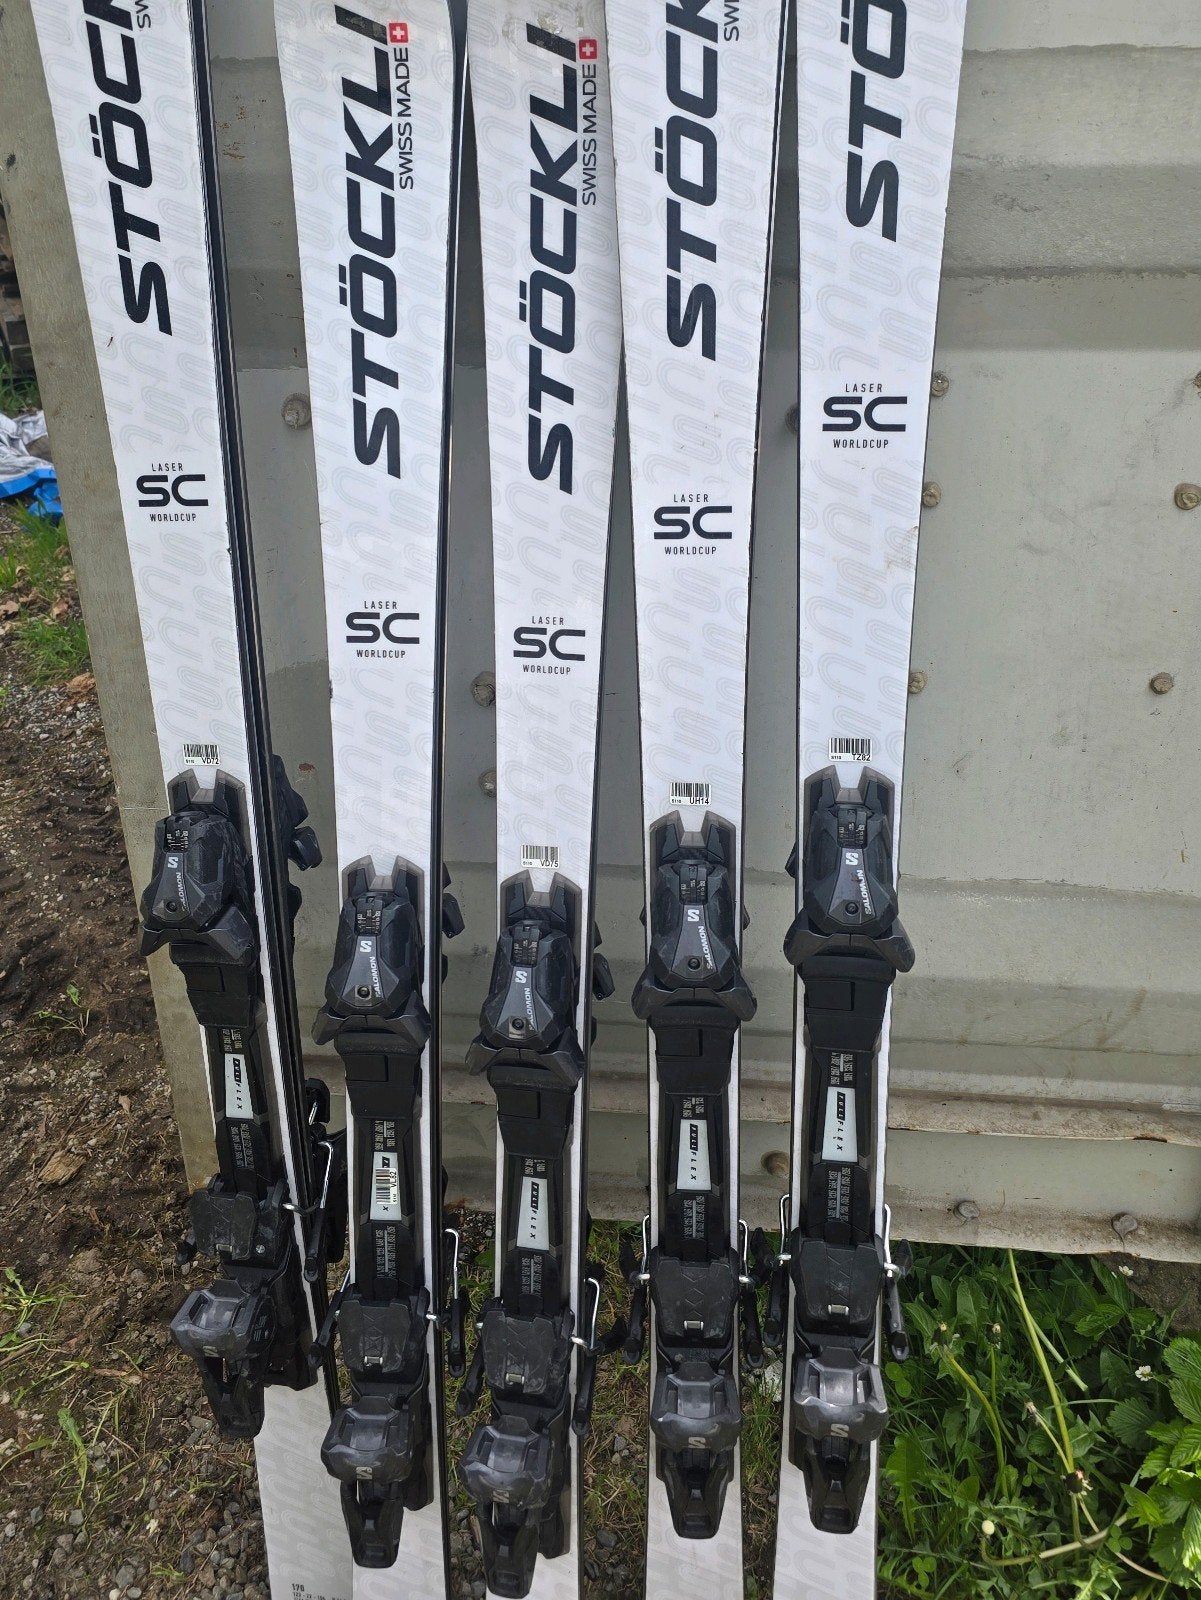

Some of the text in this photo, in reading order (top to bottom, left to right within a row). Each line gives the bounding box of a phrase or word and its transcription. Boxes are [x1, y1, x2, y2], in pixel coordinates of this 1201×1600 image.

[396, 48, 413, 191] SWISS MADE
[582, 64, 597, 205] SWISS MADE
[335, 5, 401, 479] STÖCKLI
[519, 23, 576, 495] STÖCKLI
[845, 383, 883, 393] LASER
[823, 397, 907, 431] SC
[833, 439, 889, 449] WORLDCUP
[151, 462, 184, 472] LASER
[137, 474, 208, 507] SC
[673, 493, 709, 503] LASER
[149, 513, 197, 522] WORLDCUP
[654, 506, 732, 539] SC
[664, 546, 717, 555] WORLDCUP
[364, 600, 397, 610] LASER
[531, 615, 564, 626] LASER
[346, 612, 419, 644] SC
[514, 627, 585, 661] SC
[356, 649, 406, 659] WORLDCUP
[522, 664, 571, 675] WORLDCUP
[690, 797, 709, 805] UH14
